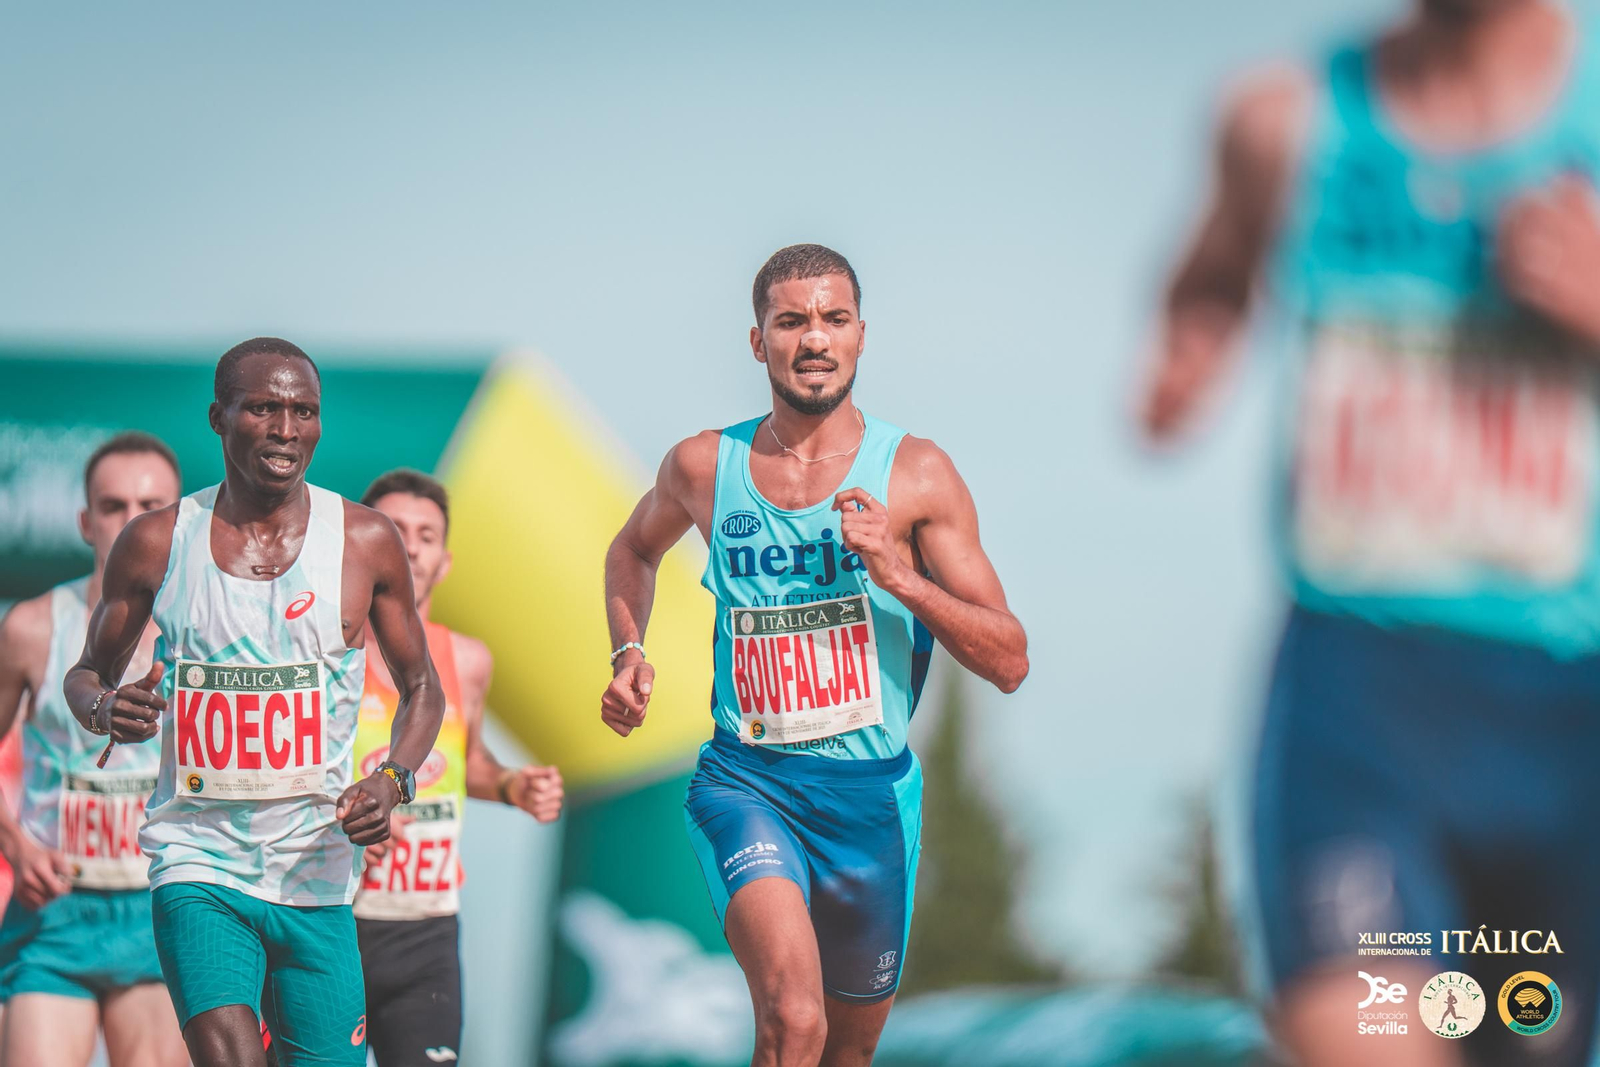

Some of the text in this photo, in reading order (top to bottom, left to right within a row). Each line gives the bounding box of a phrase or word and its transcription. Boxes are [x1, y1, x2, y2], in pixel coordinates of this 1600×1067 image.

[723, 516, 760, 534] TROPS
[761, 609, 830, 630] ITÁLICA
[214, 668, 285, 687] ITÁLICA
[735, 623, 871, 715] BOUFALJAT
[178, 690, 322, 771] KOECH
[723, 841, 779, 869] nerja
[728, 858, 782, 881] RUNOPRO
